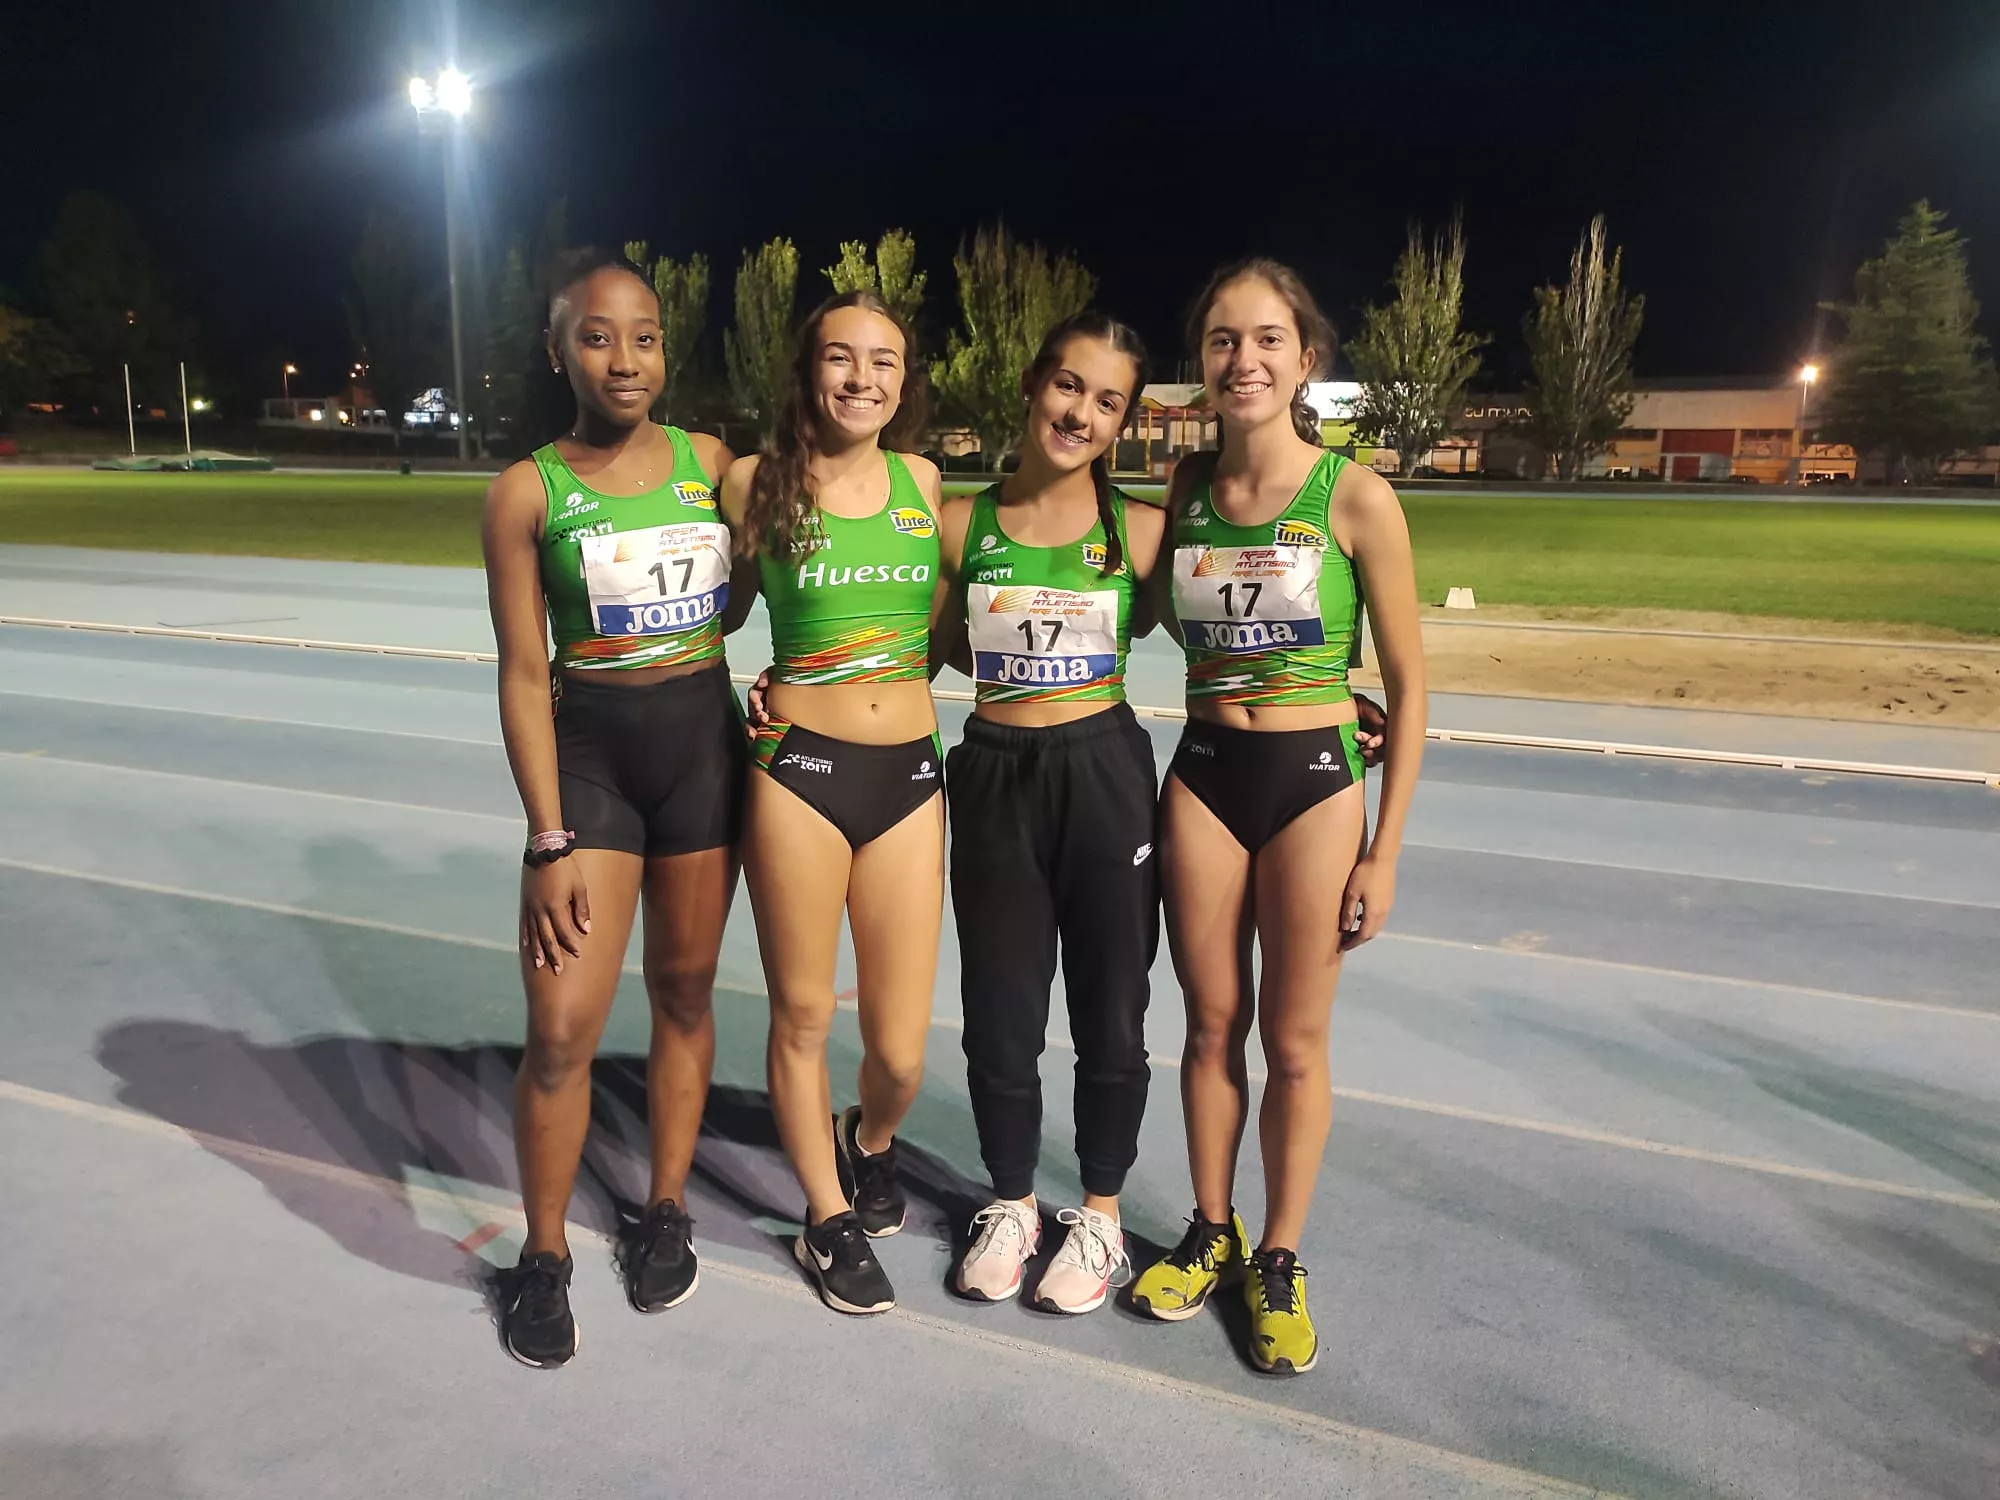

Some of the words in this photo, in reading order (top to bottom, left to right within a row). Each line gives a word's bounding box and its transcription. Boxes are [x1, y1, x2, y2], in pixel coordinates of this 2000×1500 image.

[894, 516, 933, 528] Intec
[1276, 527, 1326, 546] Intec
[647, 557, 695, 596] 17
[797, 562, 930, 589] Huesca
[977, 567, 1013, 582] ZOITI
[626, 592, 716, 634] Joma
[1217, 582, 1263, 618] 17
[1016, 619, 1064, 652] 17
[1203, 621, 1299, 649] Joma
[997, 654, 1094, 682] Joma
[800, 760, 832, 774] ZOITI
[911, 771, 936, 780] VIATOR
[1308, 763, 1340, 772] VIATOR
